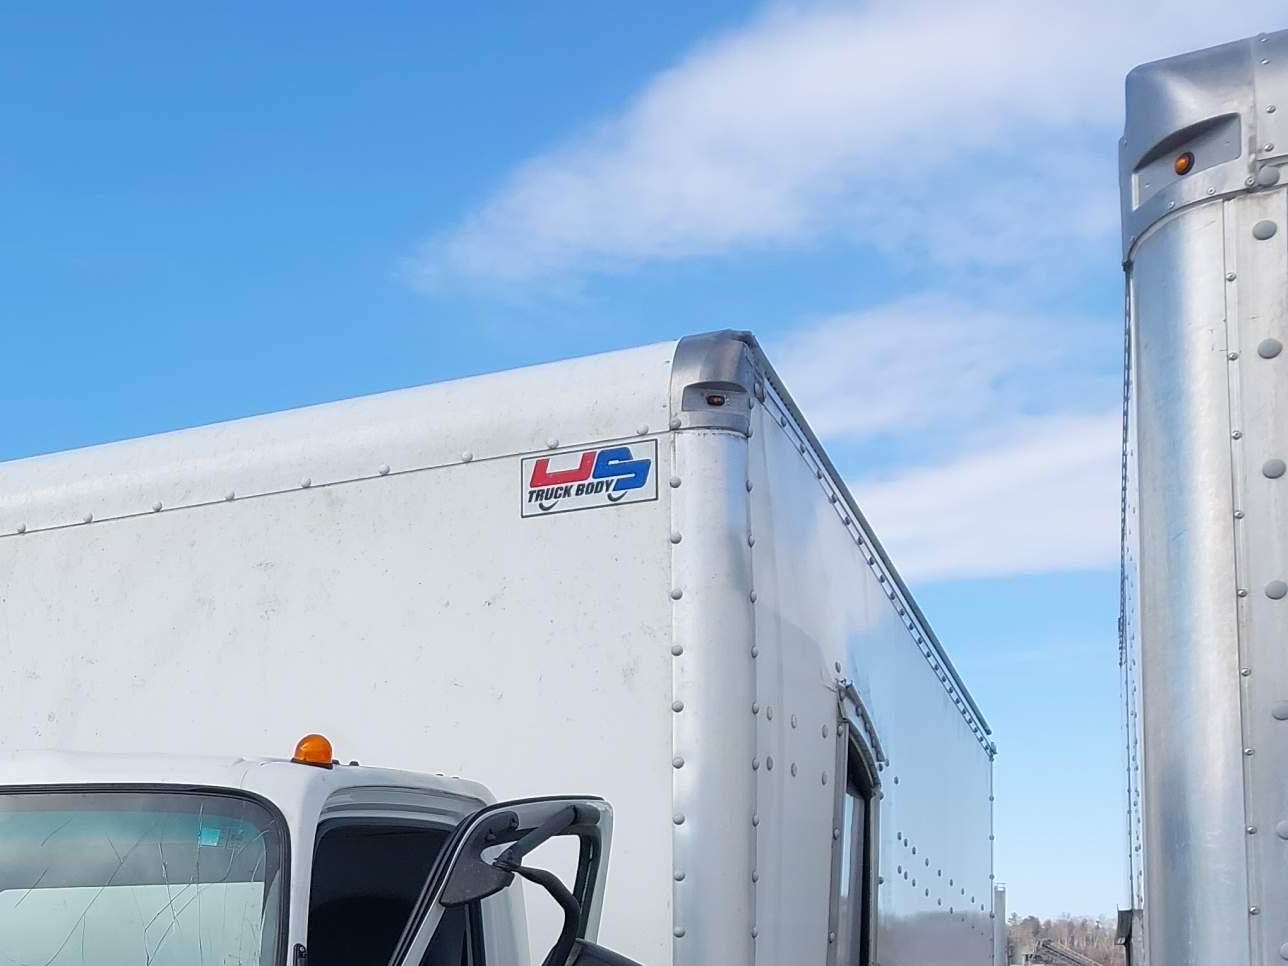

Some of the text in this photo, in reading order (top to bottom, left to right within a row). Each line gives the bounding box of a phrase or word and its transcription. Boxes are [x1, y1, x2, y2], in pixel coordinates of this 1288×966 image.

[530, 447, 651, 493] US
[528, 479, 615, 503] TRUCK BODY
